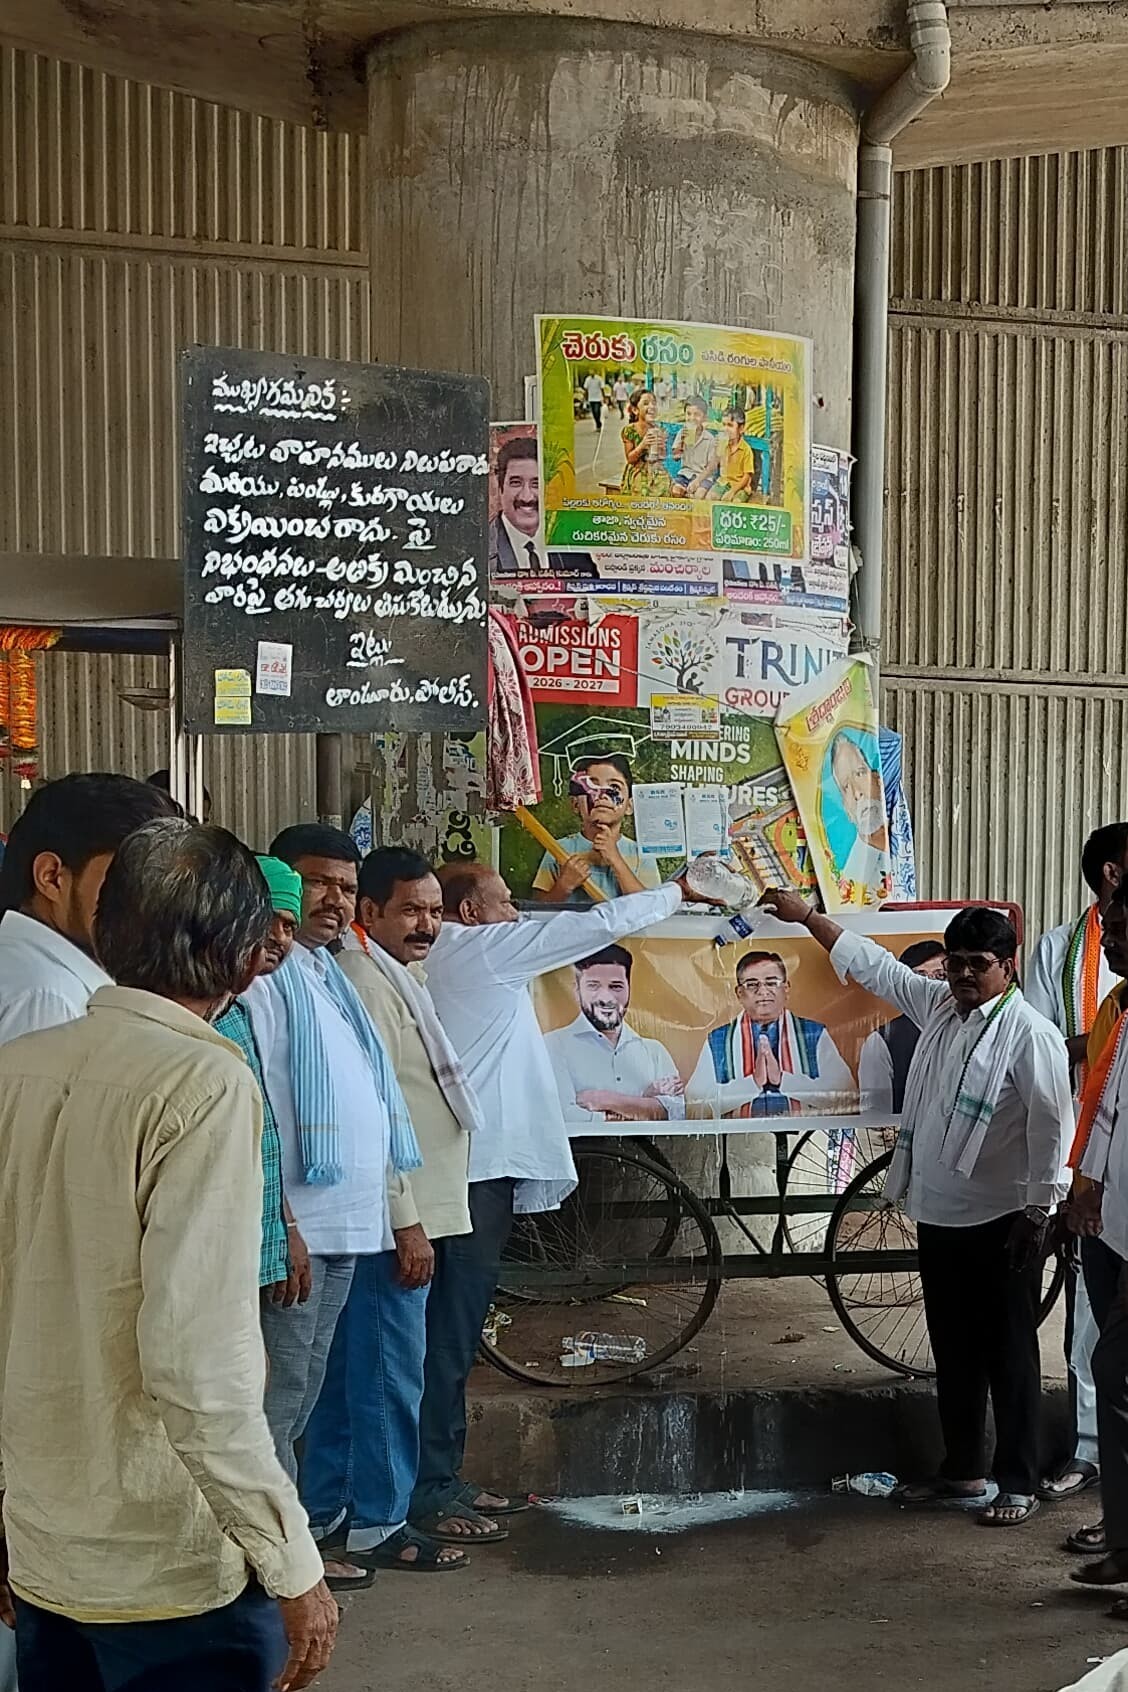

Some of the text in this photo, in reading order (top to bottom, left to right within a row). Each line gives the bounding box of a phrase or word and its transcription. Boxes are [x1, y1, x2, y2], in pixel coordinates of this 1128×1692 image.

[562, 332, 636, 362] చెరుకు
[641, 335, 695, 364] రసం
[631, 532, 661, 544] చెరుకు
[663, 534, 687, 545] రసం
[519, 644, 620, 677] OPEN
[533, 676, 562, 689] 2026
[573, 679, 604, 690] 2027
[670, 739, 752, 764] MINDS
[670, 763, 724, 783] SHAPING
